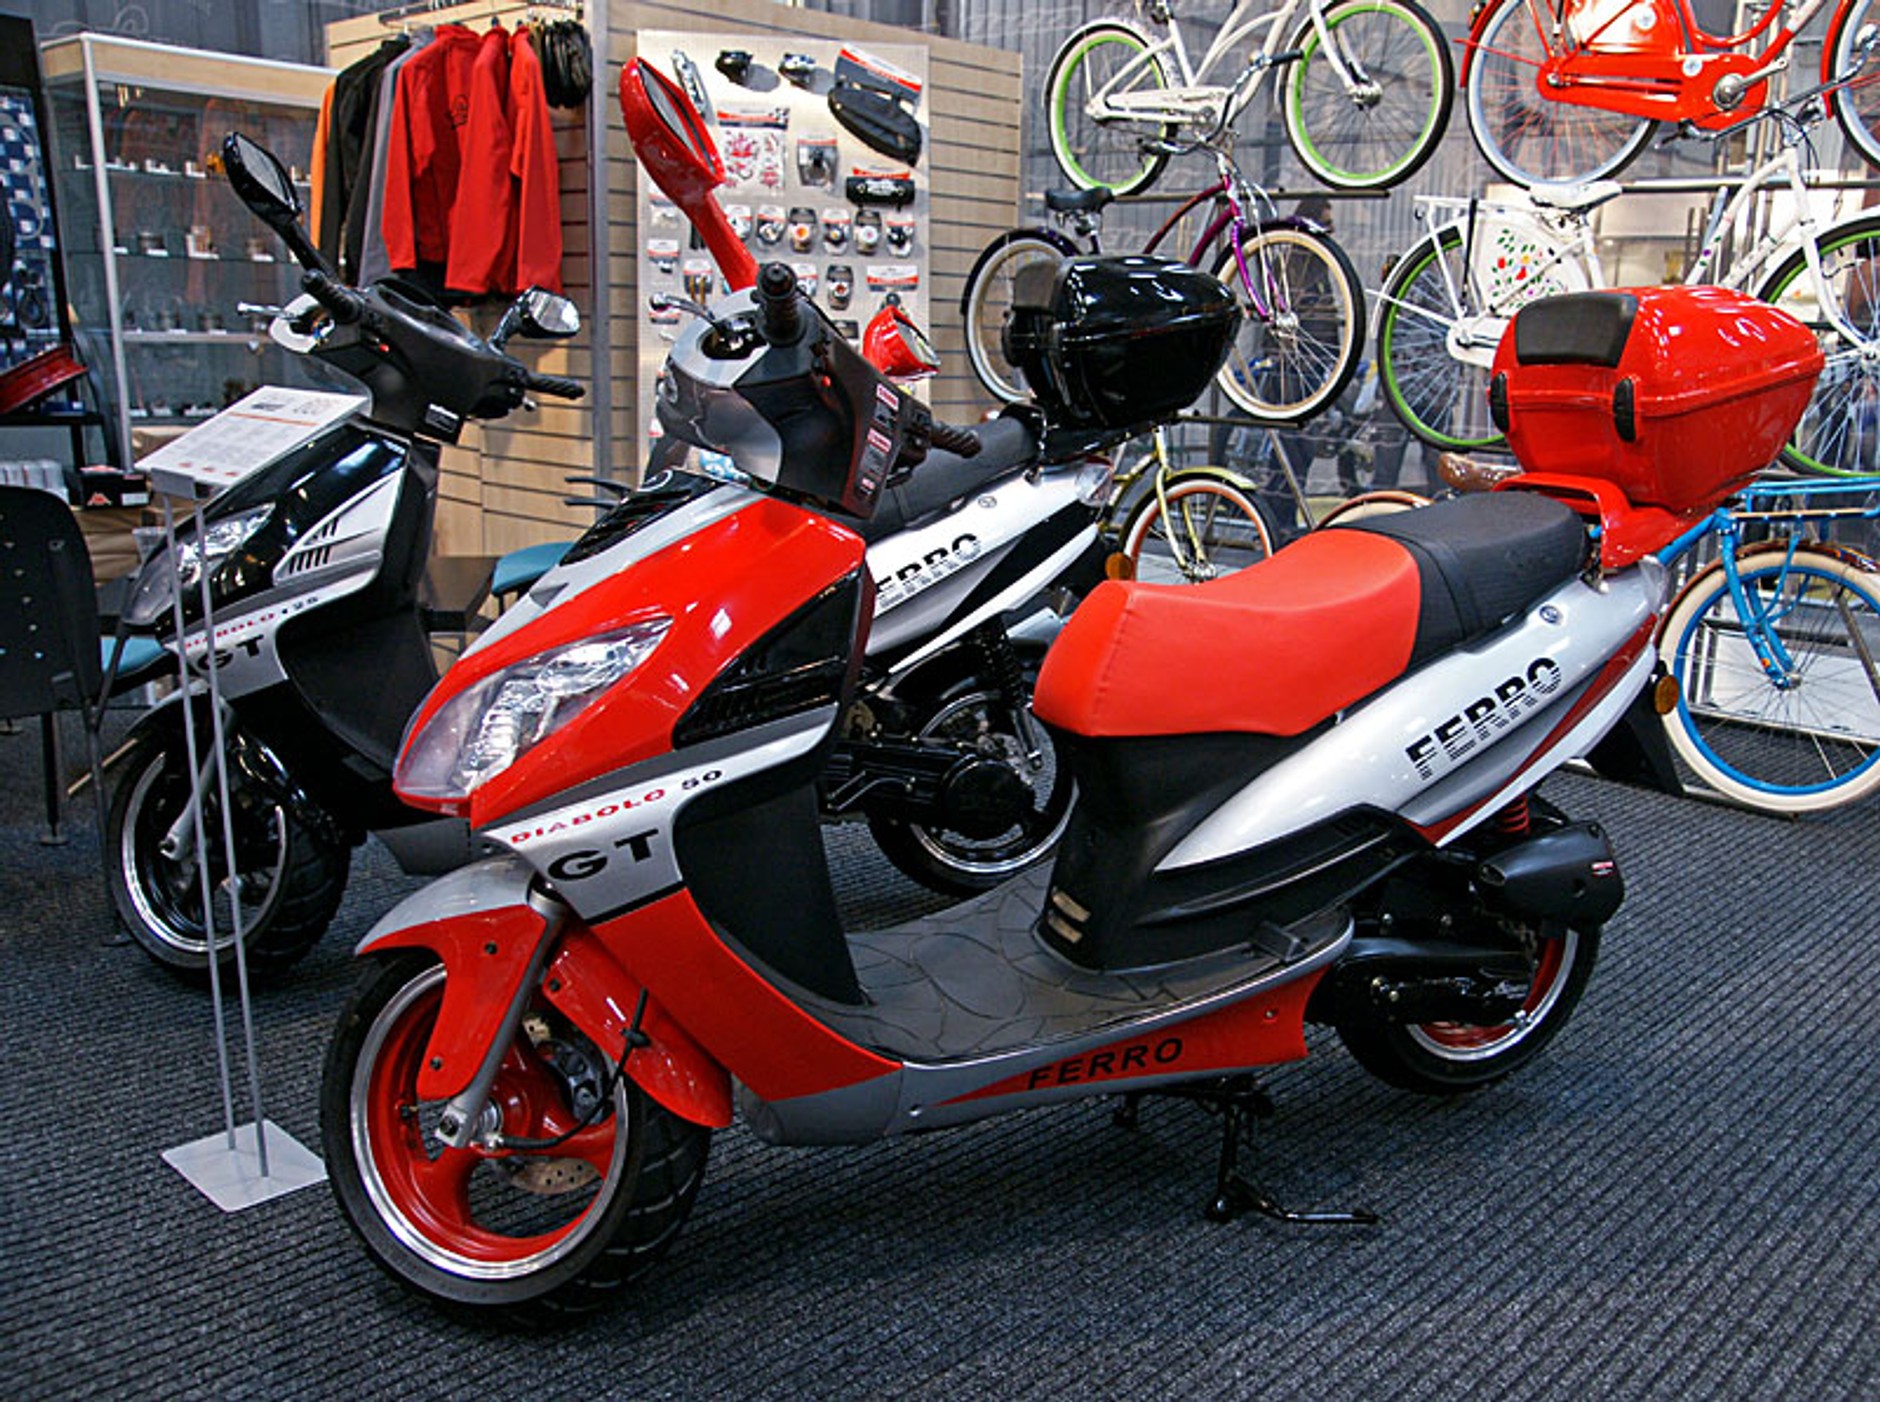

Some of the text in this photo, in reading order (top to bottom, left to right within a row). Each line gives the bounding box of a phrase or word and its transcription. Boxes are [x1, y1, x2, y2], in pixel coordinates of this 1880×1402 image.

[876, 533, 982, 608] ERRO
[198, 634, 265, 671] GT
[1405, 657, 1562, 781] FERRO
[511, 769, 723, 844] DIABOLO 50
[547, 827, 660, 882] GT
[1028, 1037, 1183, 1091] FERRO
